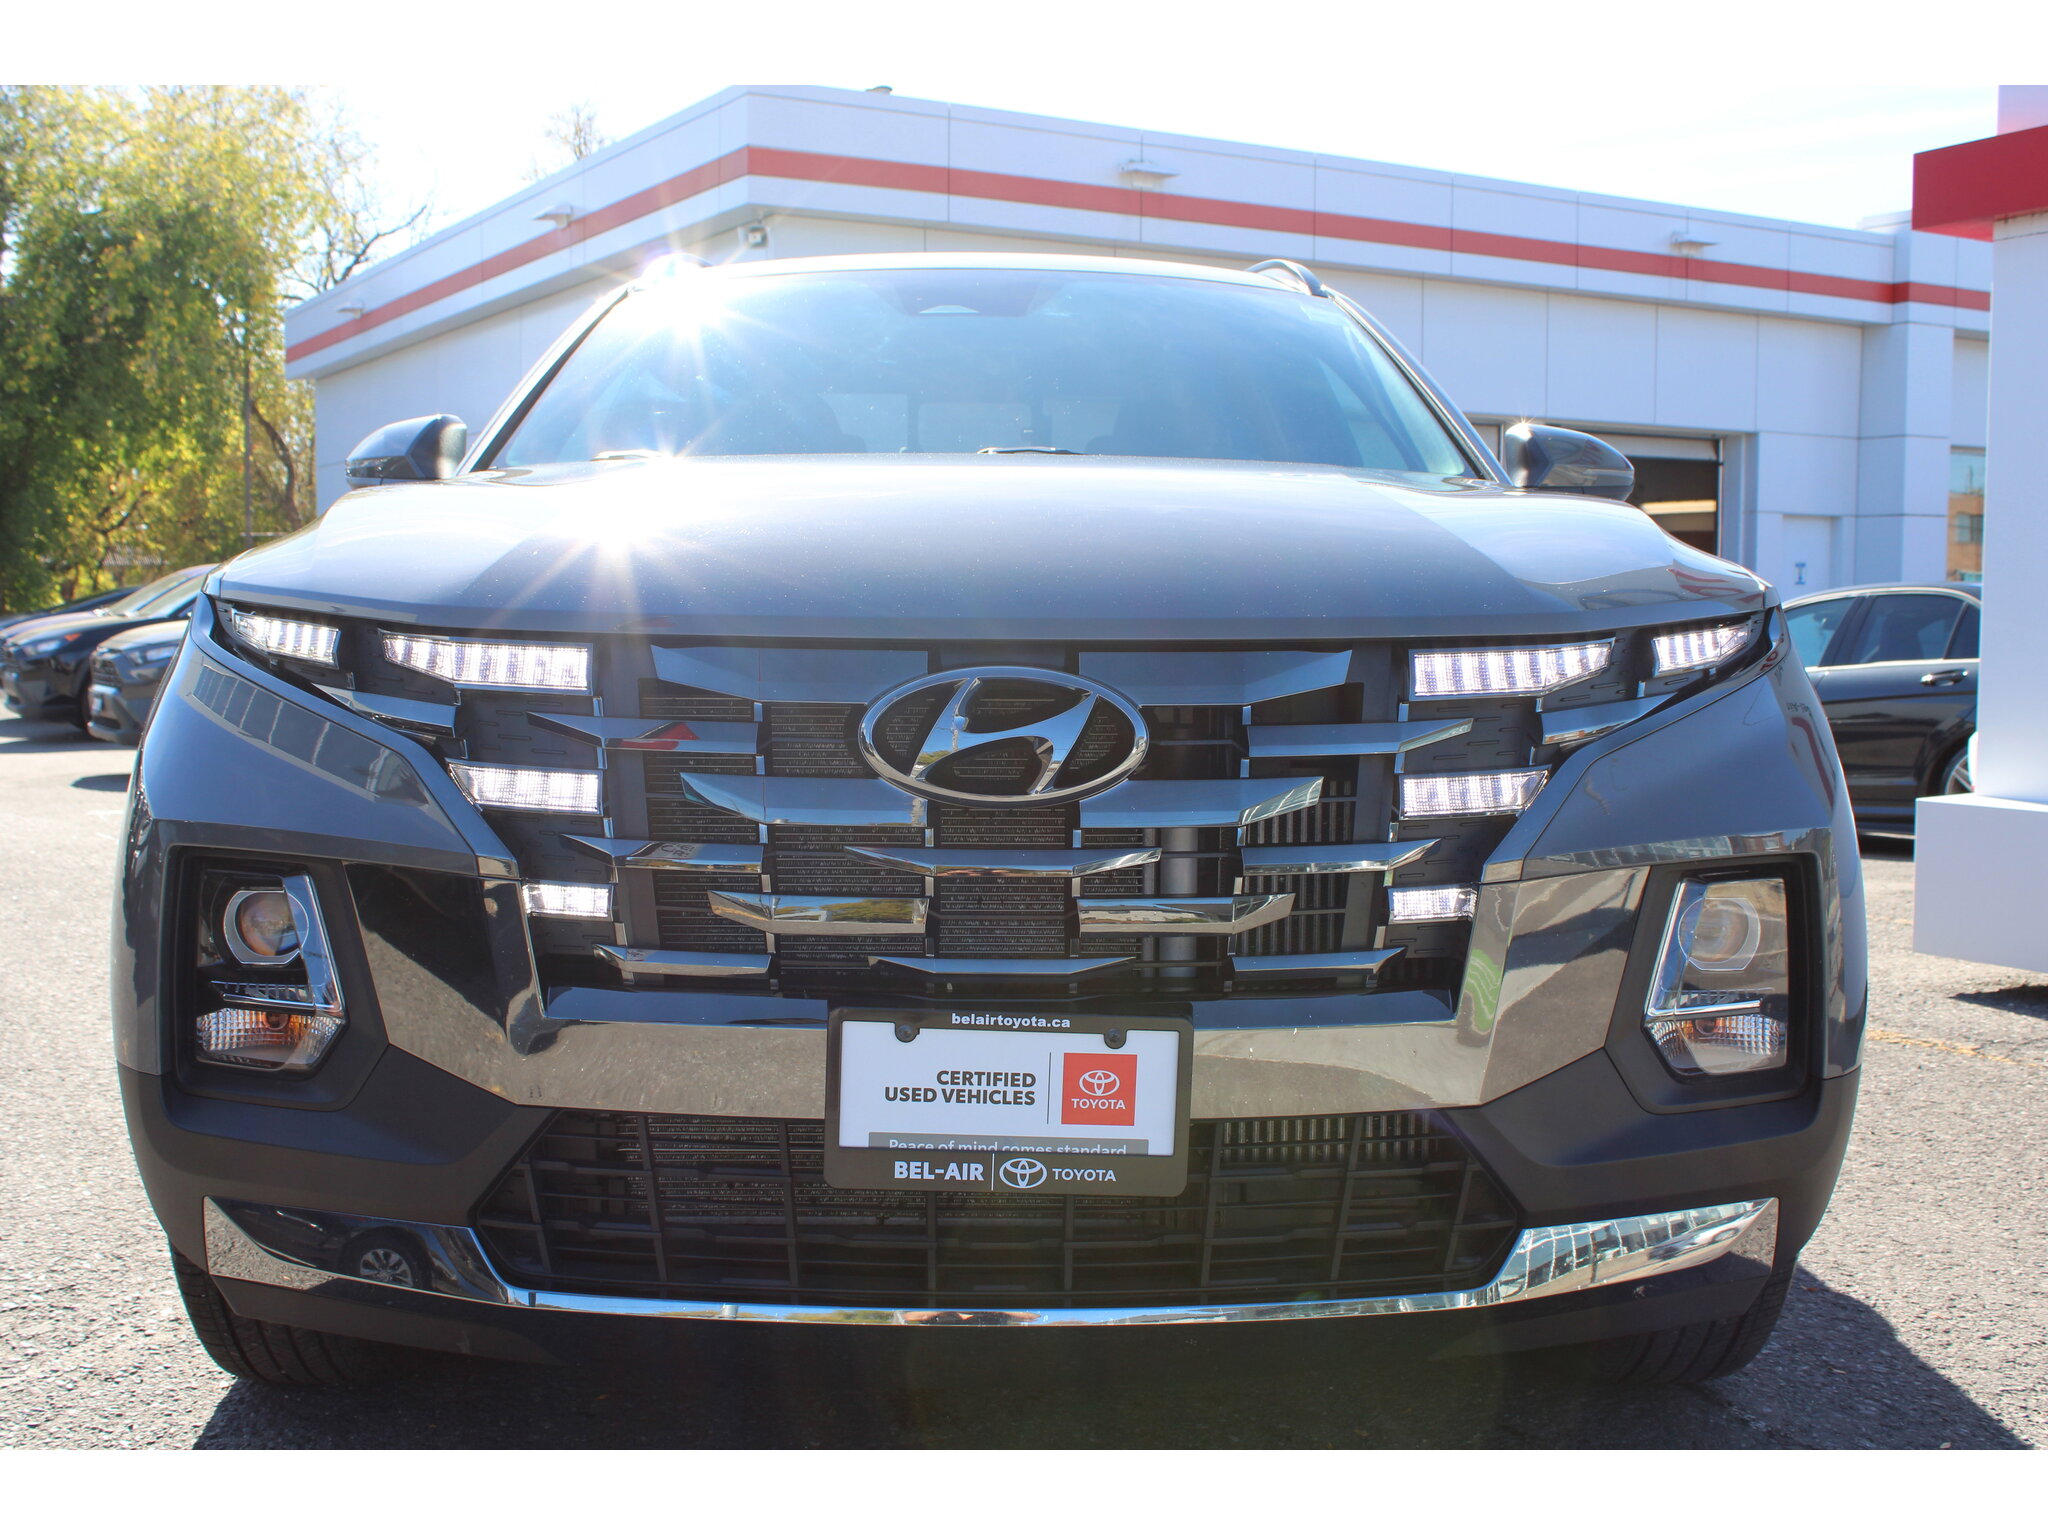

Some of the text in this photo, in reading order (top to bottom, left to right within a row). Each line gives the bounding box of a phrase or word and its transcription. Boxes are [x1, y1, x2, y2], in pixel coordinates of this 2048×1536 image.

[951, 1012, 1071, 1028] belairtoyota.ca
[936, 1070, 1036, 1087] CERTIFIED
[884, 1086, 1036, 1105] USED VEHICLES
[1071, 1098, 1126, 1110] TOYOTA
[889, 1139, 935, 1149] Peace
[938, 1140, 955, 1150] of
[959, 1141, 998, 1151] mind
[1057, 1144, 1126, 1154] standard
[894, 1160, 1116, 1182] BEL-AIR TOYOTA
